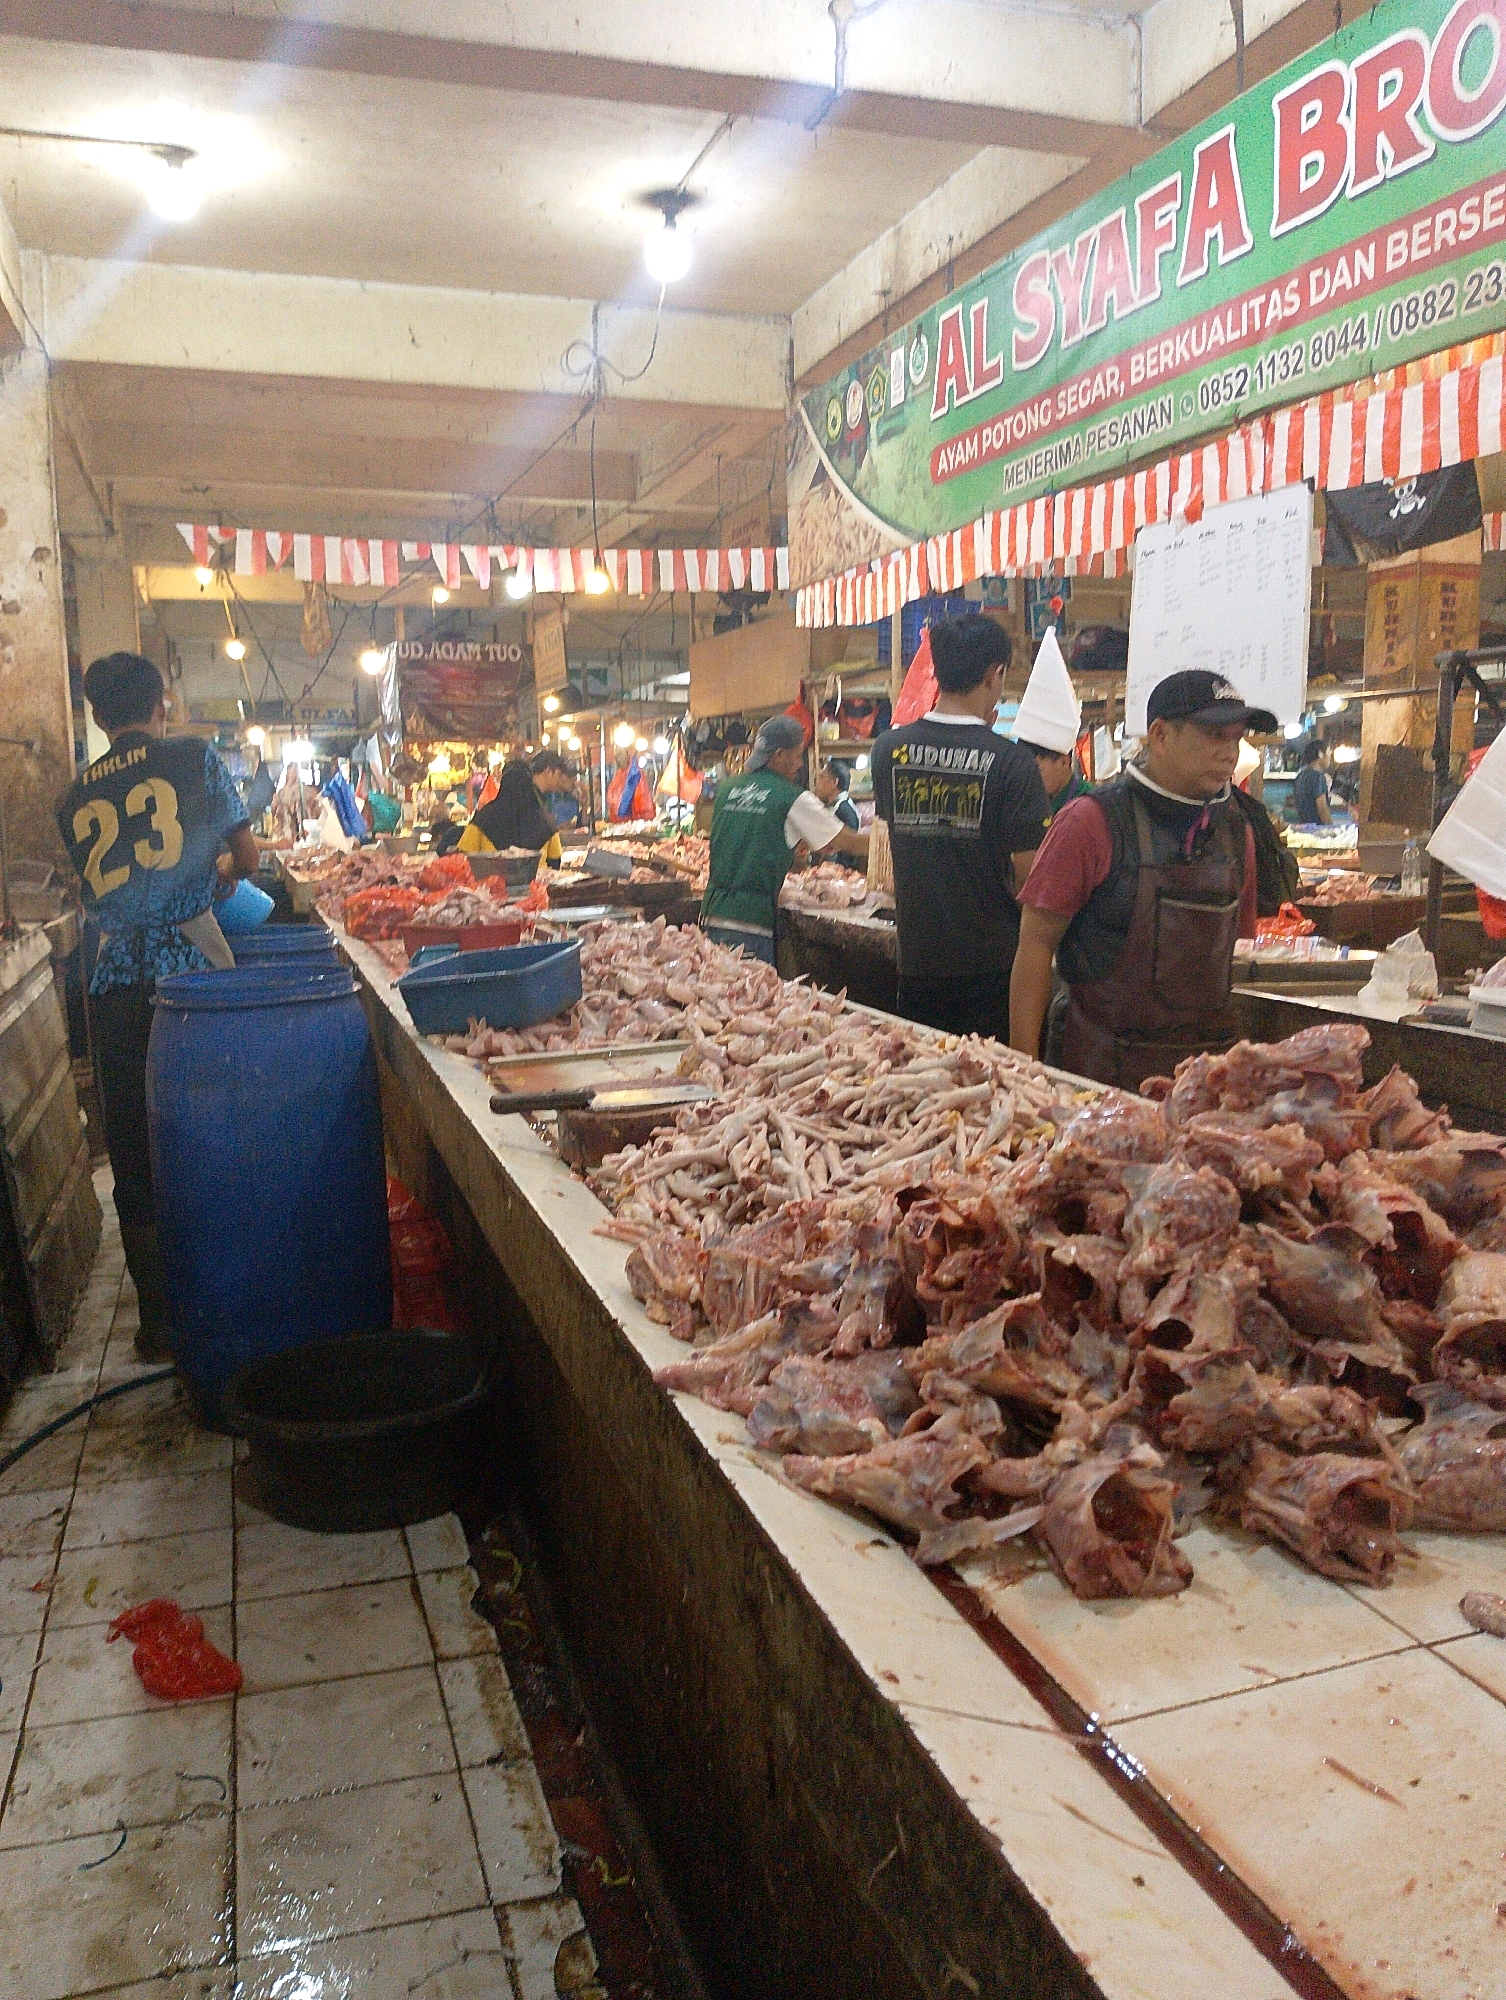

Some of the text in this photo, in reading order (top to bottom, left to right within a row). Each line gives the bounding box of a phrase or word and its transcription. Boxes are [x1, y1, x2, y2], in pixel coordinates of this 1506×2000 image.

[930, 0, 1506, 420] AL SYAFA BRO
[937, 182, 1506, 476] AYAM POTONG SEGAR, BERKUALITAS DAN BERSE
[1004, 265, 1506, 491] MENERIMA PESANAN 0852 1132 8044 / 0882 23
[72, 776, 184, 900] 23
